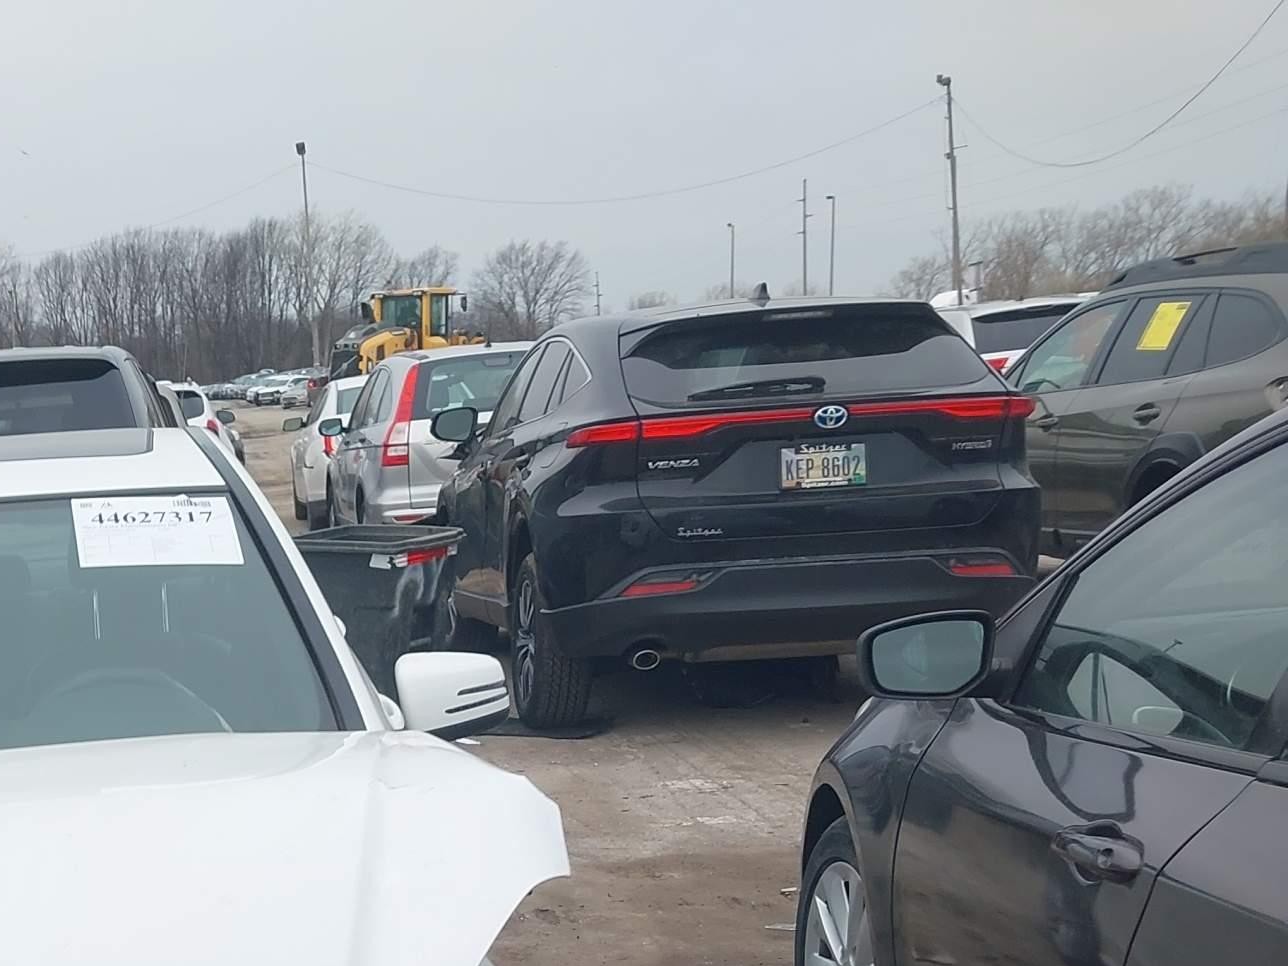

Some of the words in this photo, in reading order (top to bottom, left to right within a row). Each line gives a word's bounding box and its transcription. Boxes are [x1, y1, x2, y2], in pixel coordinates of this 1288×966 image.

[647, 458, 700, 470] VENZA
[785, 458, 815, 481] KEP
[821, 455, 862, 479] 8602
[90, 510, 213, 525] 44627317
